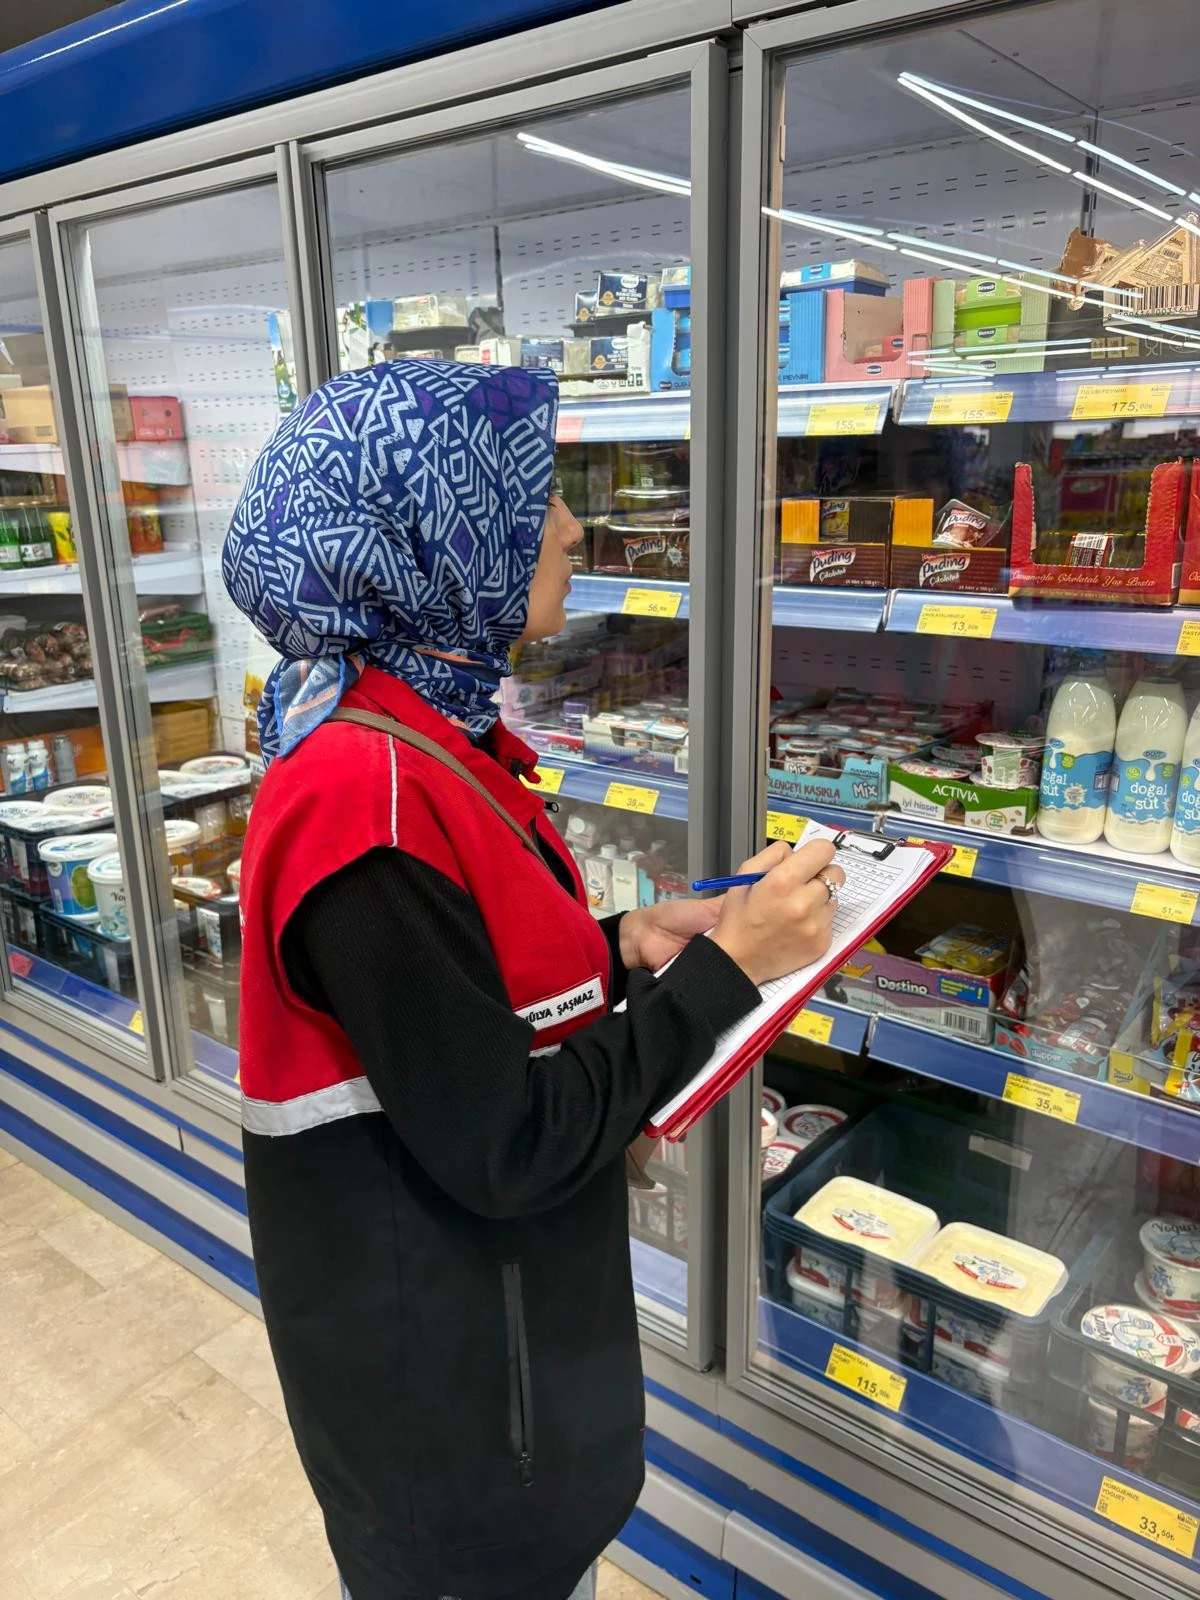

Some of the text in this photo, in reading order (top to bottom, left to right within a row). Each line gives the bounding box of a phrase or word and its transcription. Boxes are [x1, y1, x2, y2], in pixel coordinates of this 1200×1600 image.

[947, 513, 984, 527] Puding
[628, 537, 664, 562] Puding
[813, 550, 853, 572] Puding
[922, 556, 967, 578] Puding
[852, 781, 879, 799] Mix
[931, 784, 980, 804] ACTIVIA
[1130, 782, 1168, 798] doğal
[1135, 797, 1159, 810] süt
[877, 976, 929, 995] Destino
[556, 989, 595, 1016] ŞAŞMAZ
